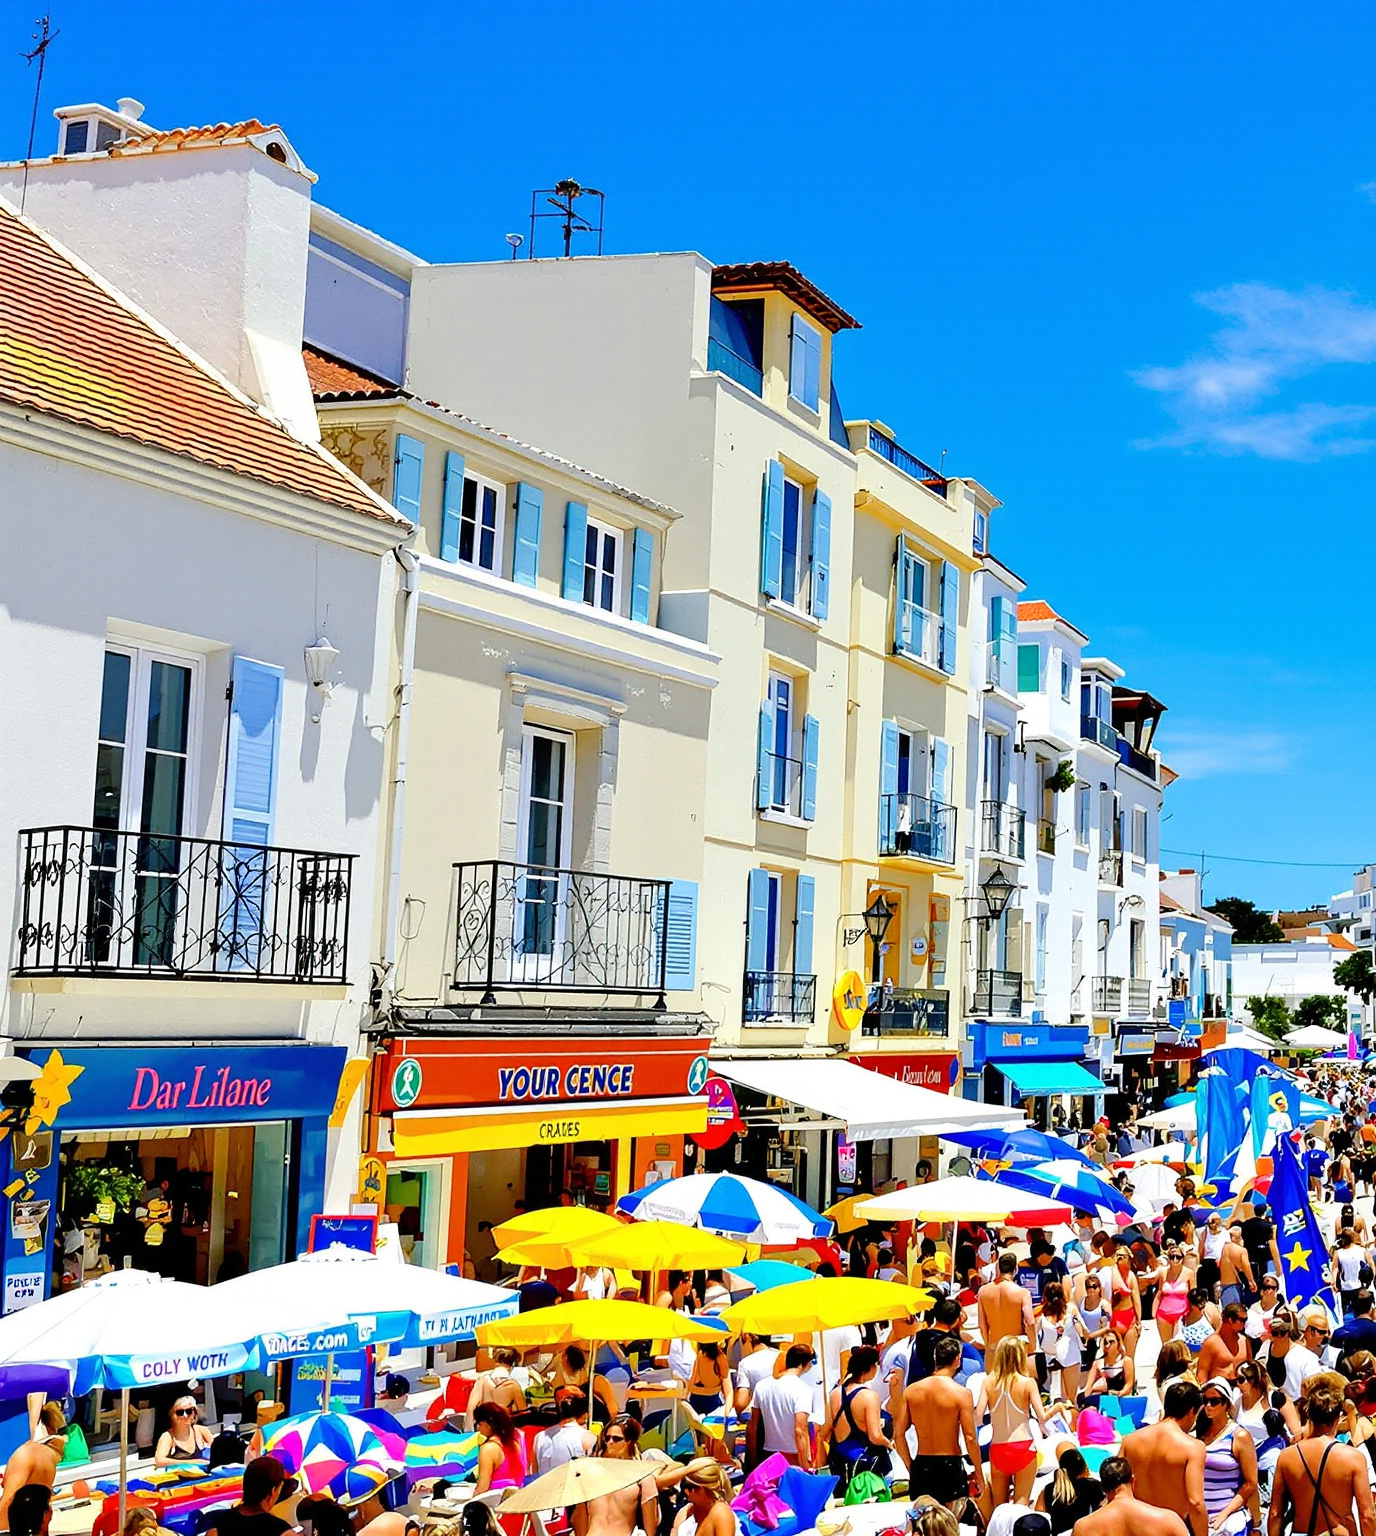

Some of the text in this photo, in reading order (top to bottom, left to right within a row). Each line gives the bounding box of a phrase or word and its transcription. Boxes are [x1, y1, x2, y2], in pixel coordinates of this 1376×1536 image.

[127, 1067, 186, 1110] Dar
[498, 1063, 634, 1100] YOUR CENCE
[143, 1358, 181, 1378] COLY
